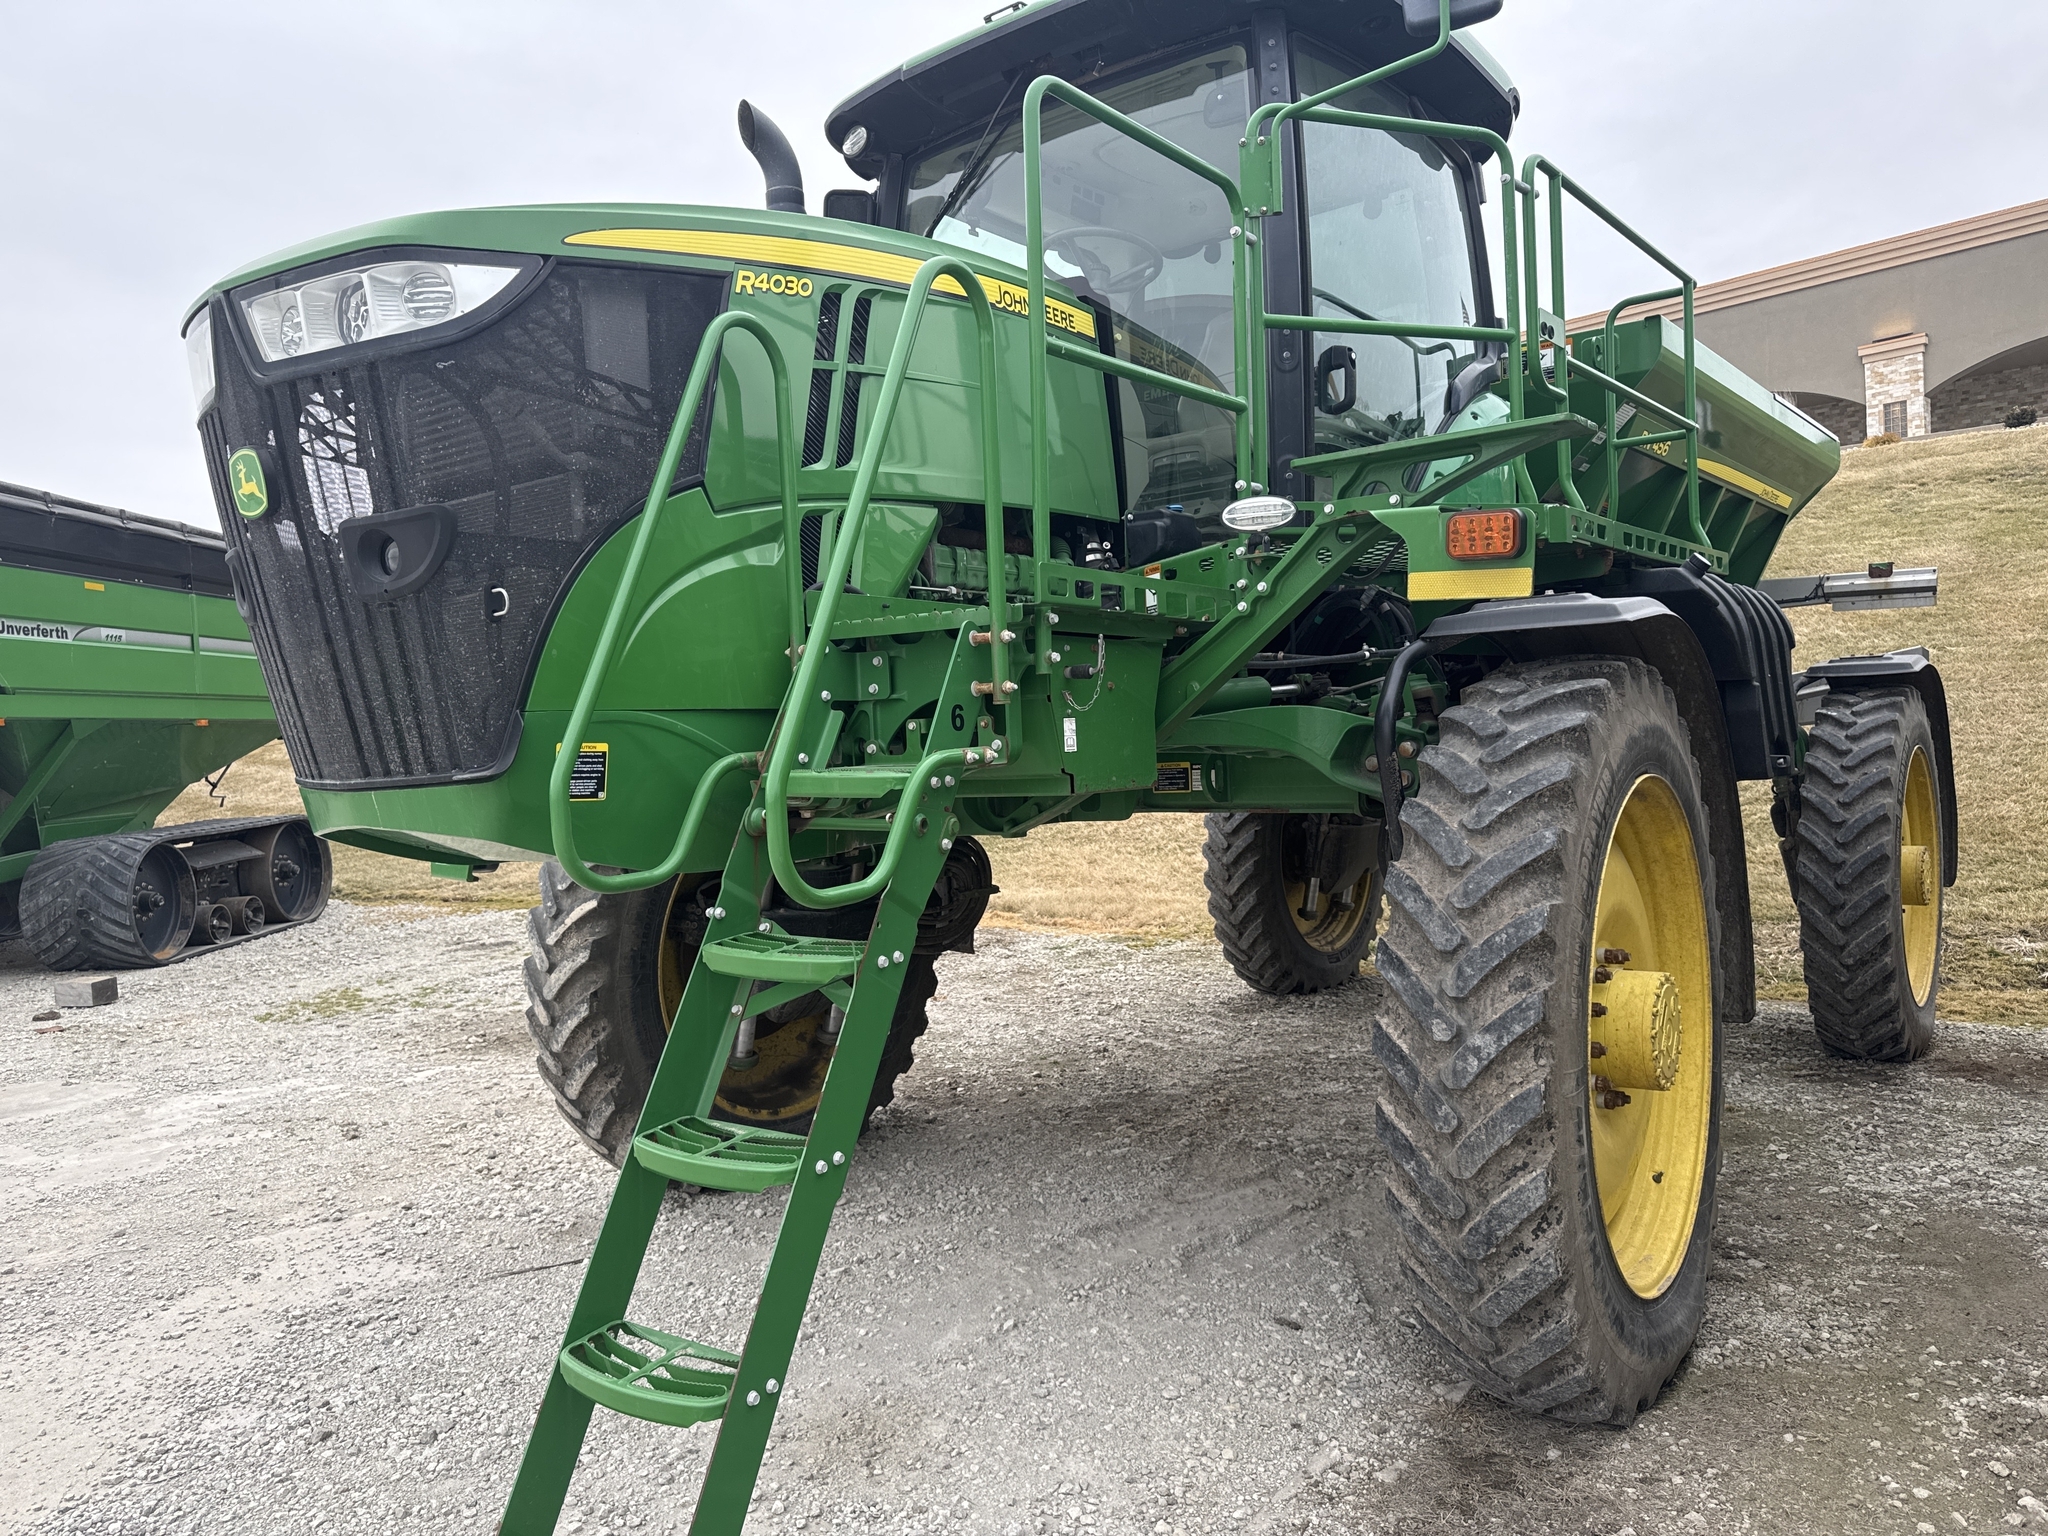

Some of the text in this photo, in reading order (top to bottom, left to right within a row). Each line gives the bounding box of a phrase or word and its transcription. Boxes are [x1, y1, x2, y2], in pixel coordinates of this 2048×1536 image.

[734, 269, 813, 297] R4030
[1045, 304, 1077, 331] EERE
[104, 633, 123, 642] 1115
[951, 703, 965, 731] 6
[1570, 936, 1582, 1020] MICHELIN
